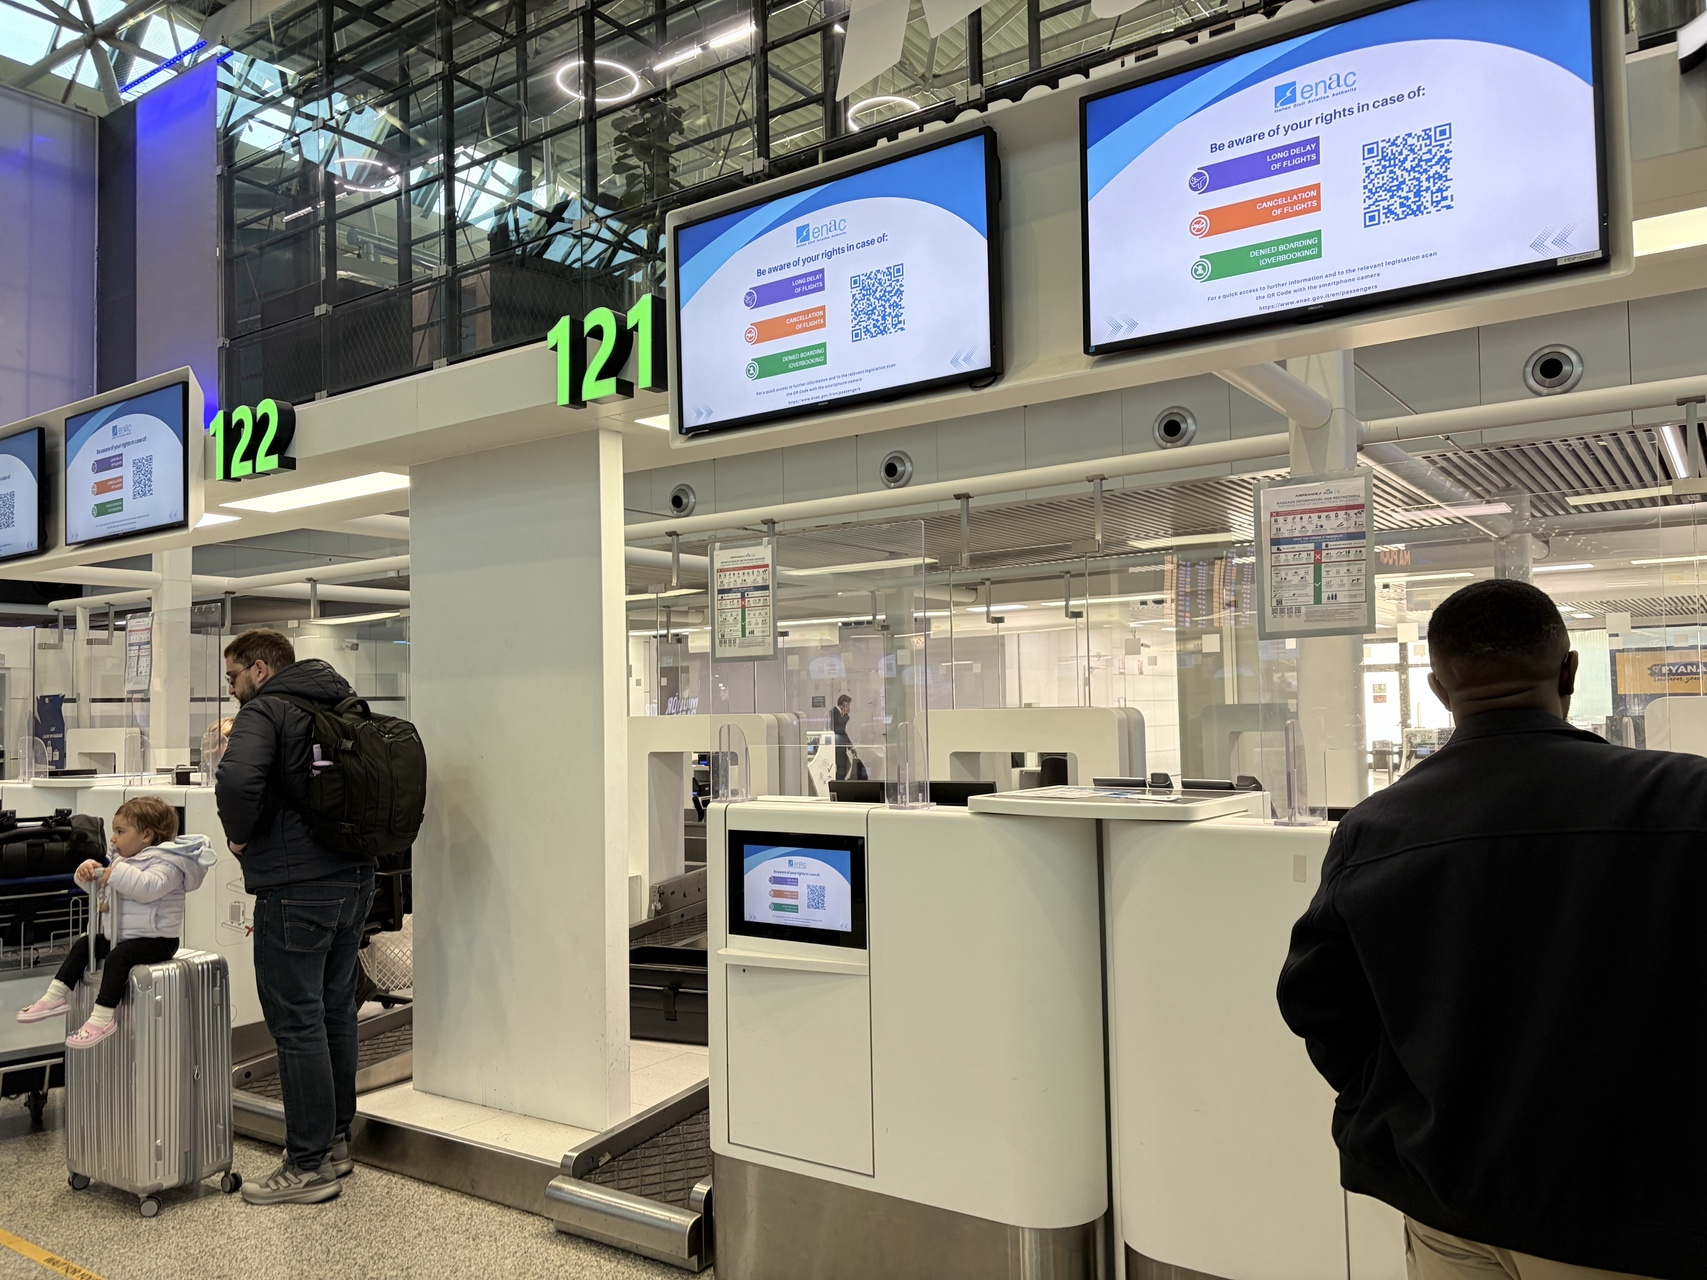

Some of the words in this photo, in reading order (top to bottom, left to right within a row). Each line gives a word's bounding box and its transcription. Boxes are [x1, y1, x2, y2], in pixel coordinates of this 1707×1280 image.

[1300, 71, 1357, 100] enac
[1210, 143, 1225, 153] Be
[1227, 132, 1265, 149] aware
[1268, 124, 1280, 137] of
[1283, 118, 1313, 136] your
[1315, 107, 1354, 125] rights
[1357, 102, 1369, 113] in
[1372, 94, 1405, 109] case
[1407, 86, 1425, 99] of:
[1267, 150, 1289, 161] LONG
[1290, 143, 1316, 155] DELAY
[1271, 162, 1281, 170] OF
[1283, 153, 1316, 167] FLIGHTS
[1256, 190, 1317, 210] CANCELLATION
[1272, 208, 1282, 216] OF
[1284, 200, 1317, 213] FLIGHTS
[812, 218, 847, 239] enac
[757, 269, 766, 277] Be
[768, 262, 791, 274] aware
[792, 257, 800, 267] of
[801, 254, 820, 267] your
[821, 247, 845, 260] rights
[847, 243, 854, 252] in
[856, 238, 875, 249] case
[877, 233, 888, 243] of:
[1250, 246, 1277, 257] DENIED
[1279, 237, 1318, 251] BOARDING
[1259, 247, 1318, 266] (OVERBOOKING)
[792, 278, 806, 286] LONG
[806, 274, 822, 282] DELAY
[802, 282, 823, 291] FLIGHTS
[1222, 291, 1238, 299] quick
[1239, 287, 1259, 295] access
[1267, 282, 1287, 290] further
[1288, 274, 1323, 286] information
[1324, 271, 1337, 279] and
[1357, 262, 1384, 272] relevant
[1385, 255, 1420, 266] legislation
[1319, 278, 1355, 288] smartphone
[1357, 273, 1380, 281] camera
[1259, 285, 1378, 311] https://www.enac.gov.it/en/passengers
[786, 311, 823, 324] CANCELLATION
[803, 318, 824, 328] FLIGHTS
[547, 293, 653, 406] 121
[782, 354, 799, 362] DENIED
[800, 348, 824, 358] BOARDING
[209, 398, 279, 481] 122
